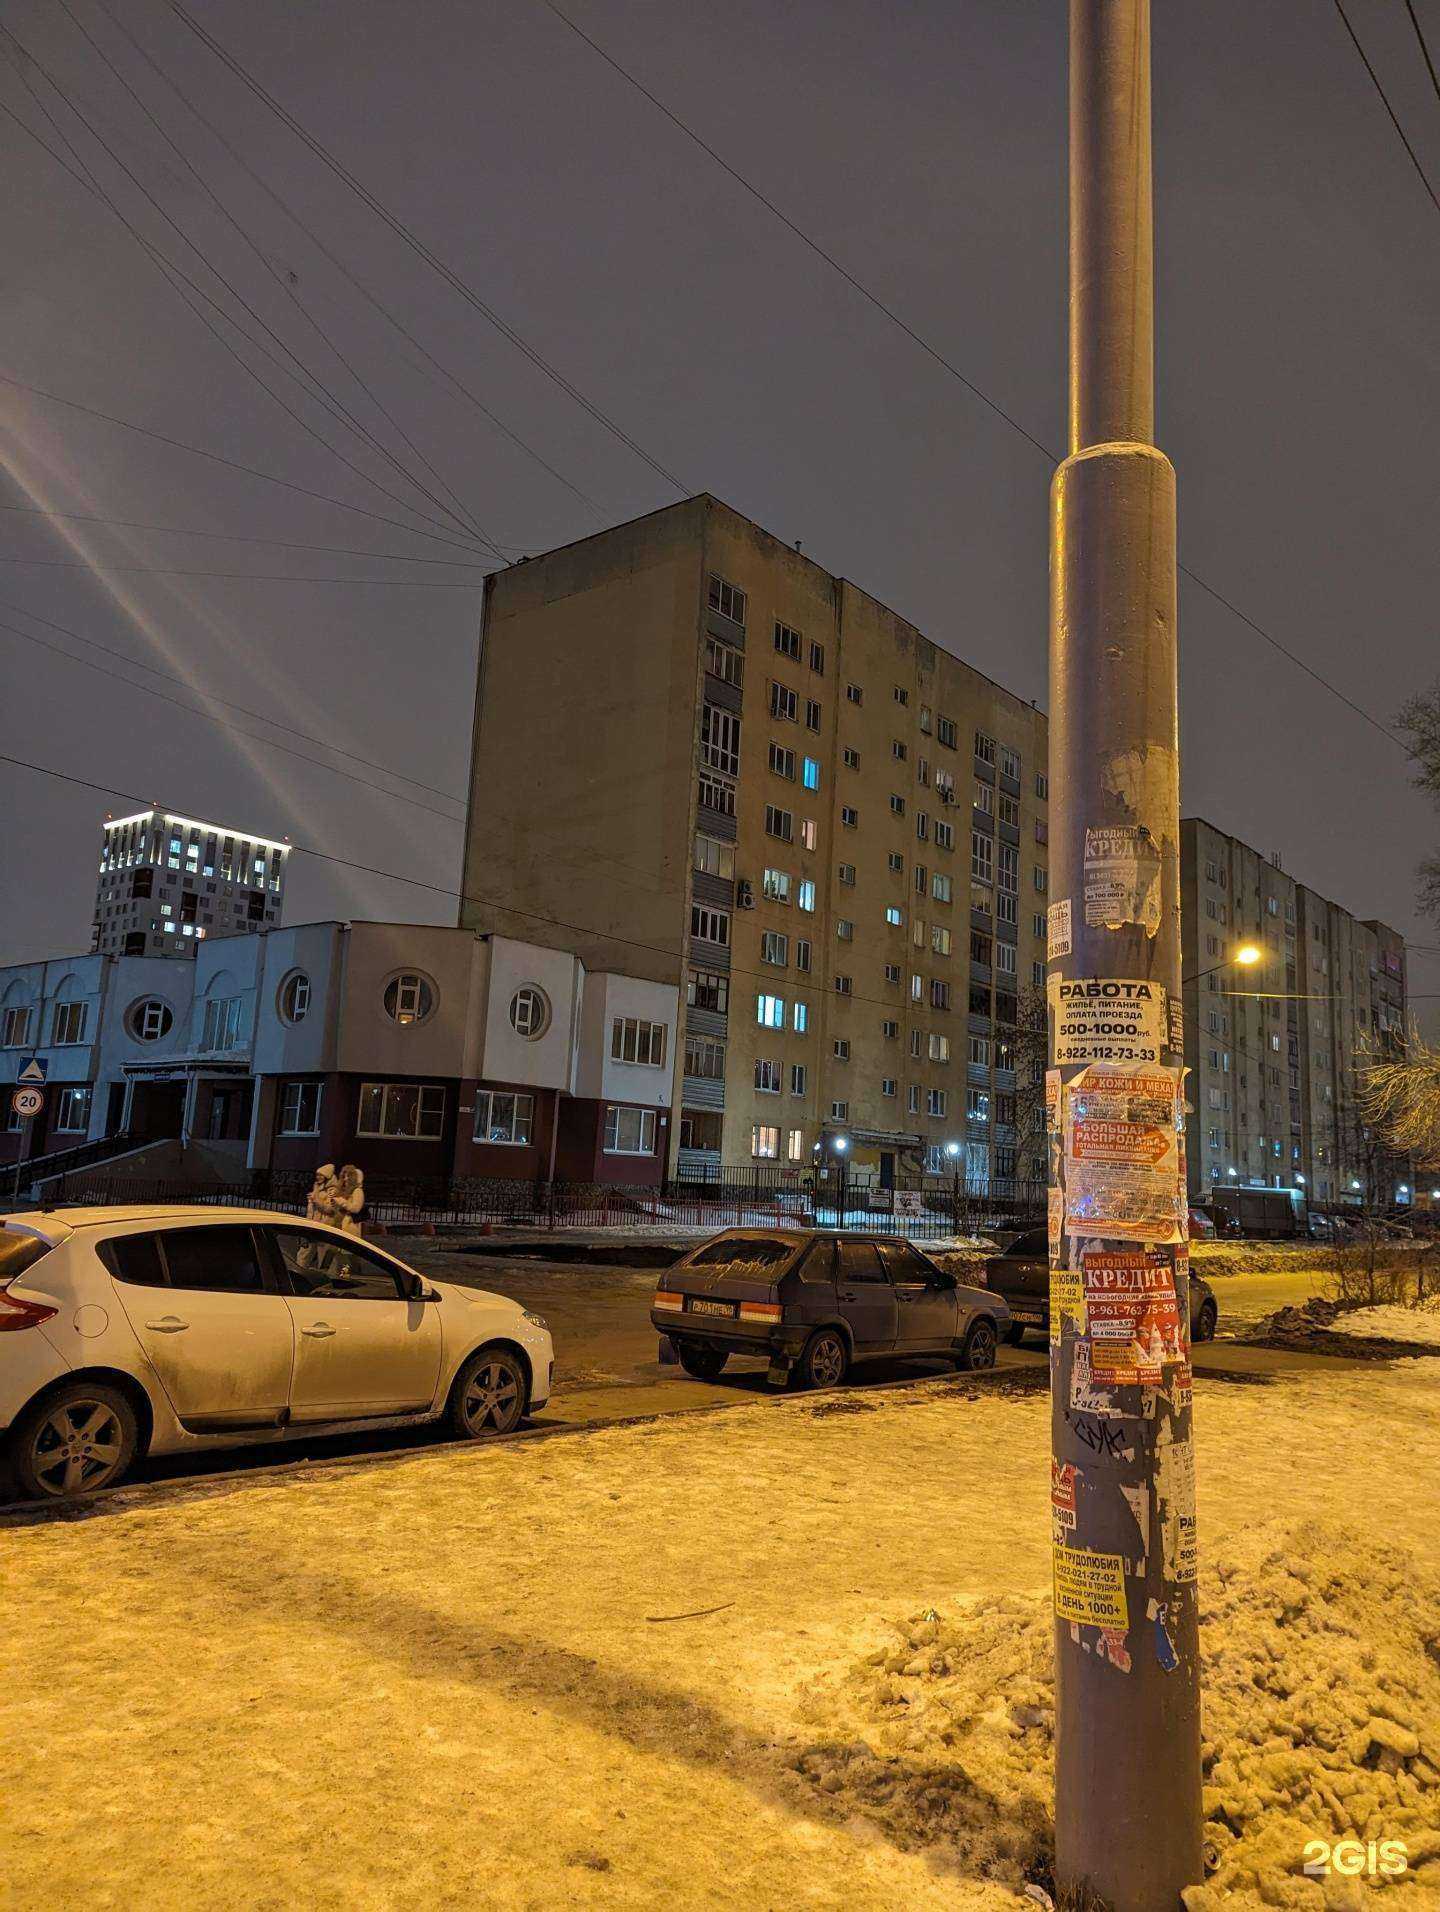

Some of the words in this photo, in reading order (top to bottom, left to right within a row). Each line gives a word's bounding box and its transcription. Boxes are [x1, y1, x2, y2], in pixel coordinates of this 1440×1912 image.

[1060, 983, 1152, 999] РАБОТА
[1098, 1001, 1144, 1010] ПИТАНИЕ,
[1066, 1011, 1097, 1020] ОПЛАТА
[1099, 1011, 1143, 1020] ПРОЕЗДА
[1060, 1023, 1137, 1035] 500-1000
[1057, 1047, 1156, 1061] 8-922-112-73-33
[1099, 1078, 1133, 1090] КОЖИ
[20, 1095, 37, 1108] 20
[1083, 1123, 1145, 1135] БОЛЬШАЯ
[1076, 1132, 1160, 1146] РАСПРОДАЖА
[1085, 1268, 1172, 1292] КРЕДИТ
[1089, 1303, 1176, 1316] 8-961-762-75-39
[1065, 1551, 1120, 1571] ТРУДОЛЮБИЯ
[1062, 1595, 1085, 1611] ДЕНЬ
[1087, 1602, 1121, 1615] 1000+
